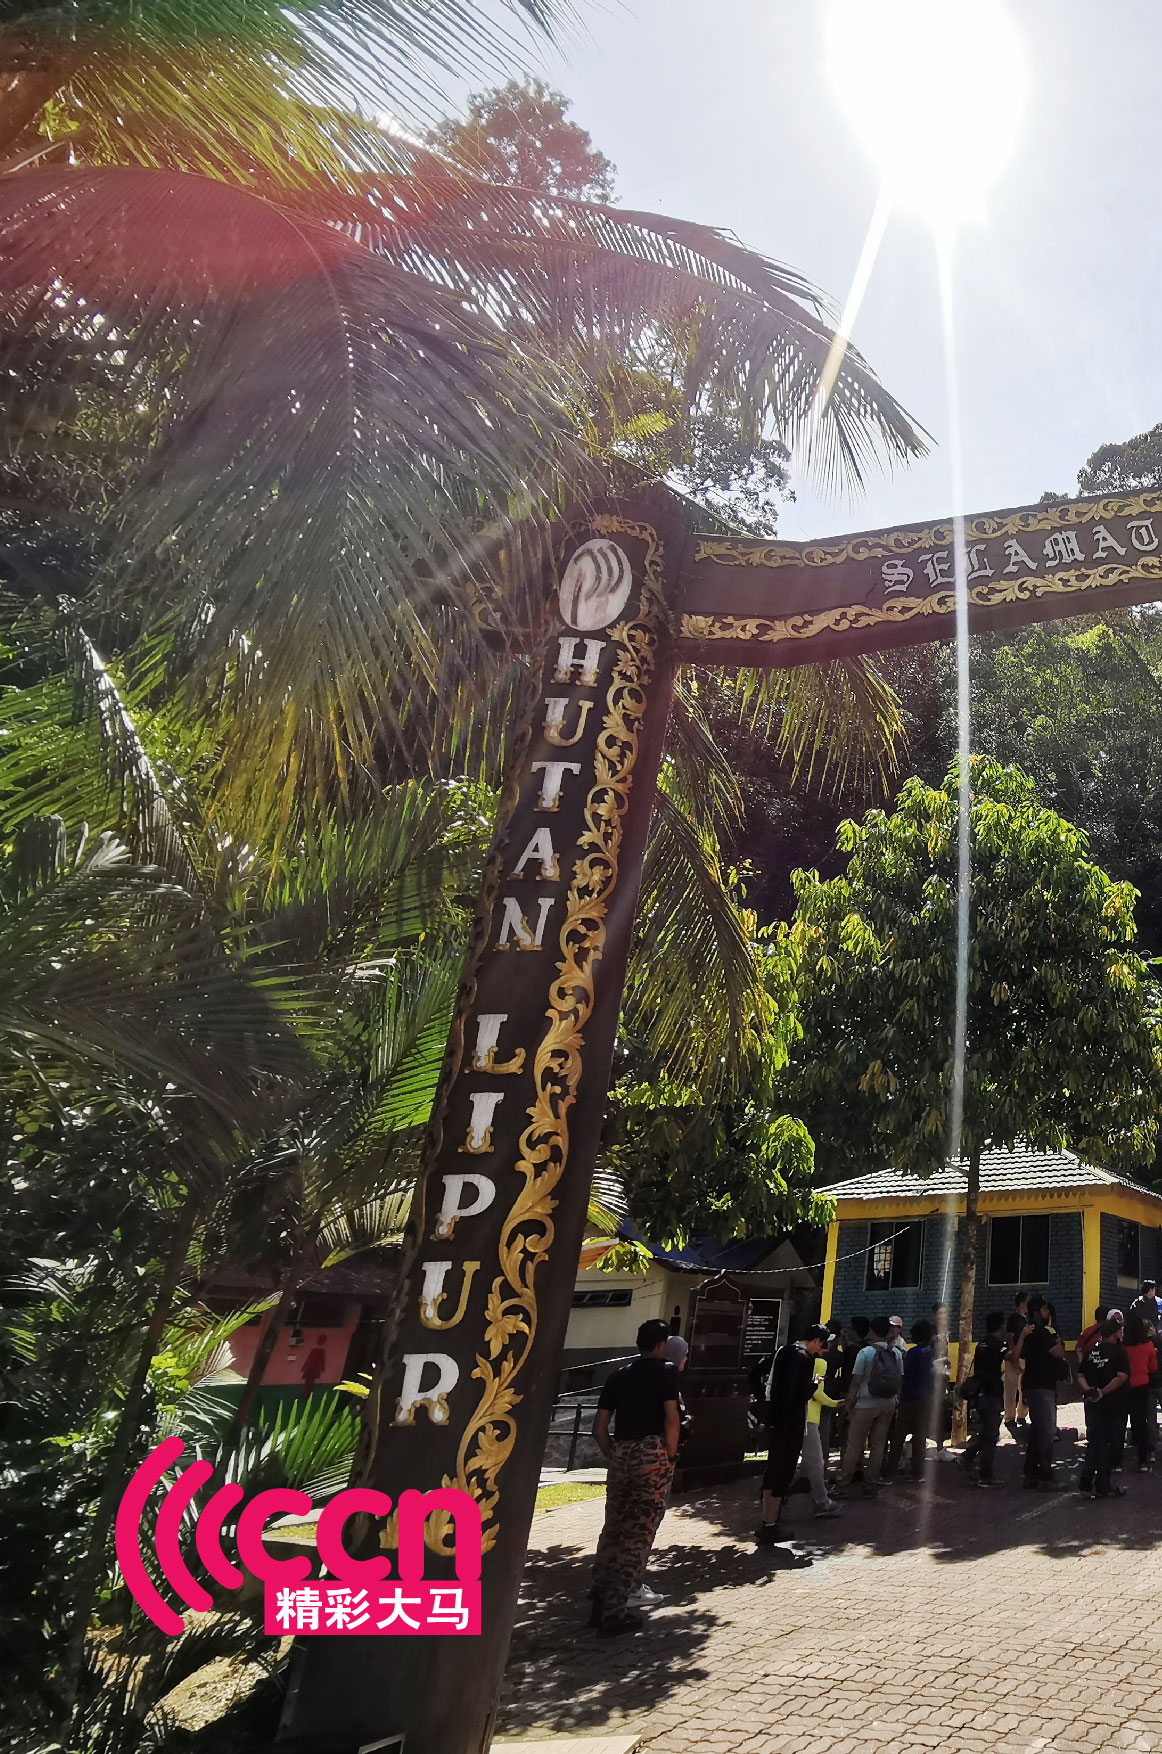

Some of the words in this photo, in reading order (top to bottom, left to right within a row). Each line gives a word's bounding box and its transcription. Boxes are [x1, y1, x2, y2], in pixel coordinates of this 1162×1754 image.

[881, 518, 1159, 595] SELAMAT
[493, 637, 606, 952] HUTAN
[389, 1013, 527, 1426] LIPUR
